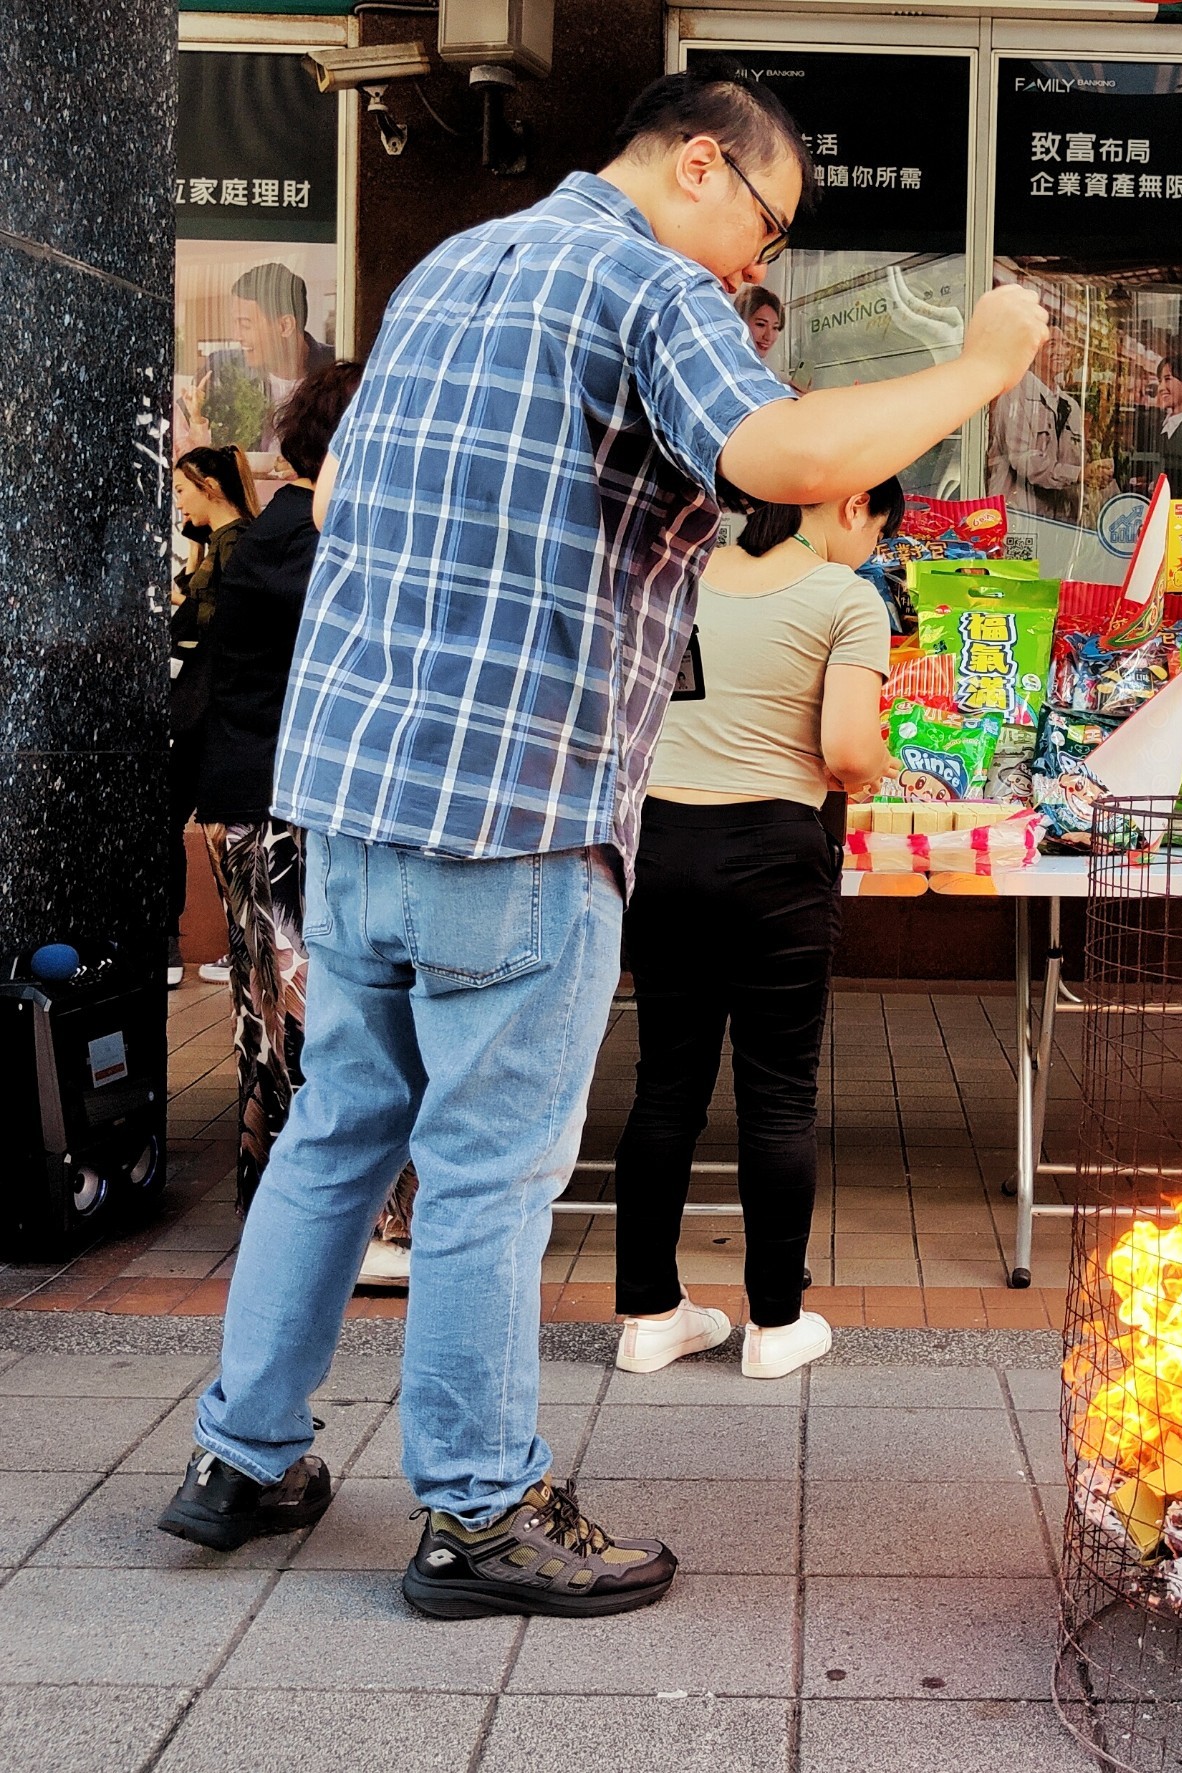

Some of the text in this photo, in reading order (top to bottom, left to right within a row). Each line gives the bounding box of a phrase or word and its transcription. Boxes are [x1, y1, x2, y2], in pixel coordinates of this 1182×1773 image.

[1015, 77, 1116, 93] FAMILY BANKING
[1031, 132, 1150, 163] 致富布局
[903, 748, 961, 787] Prince
